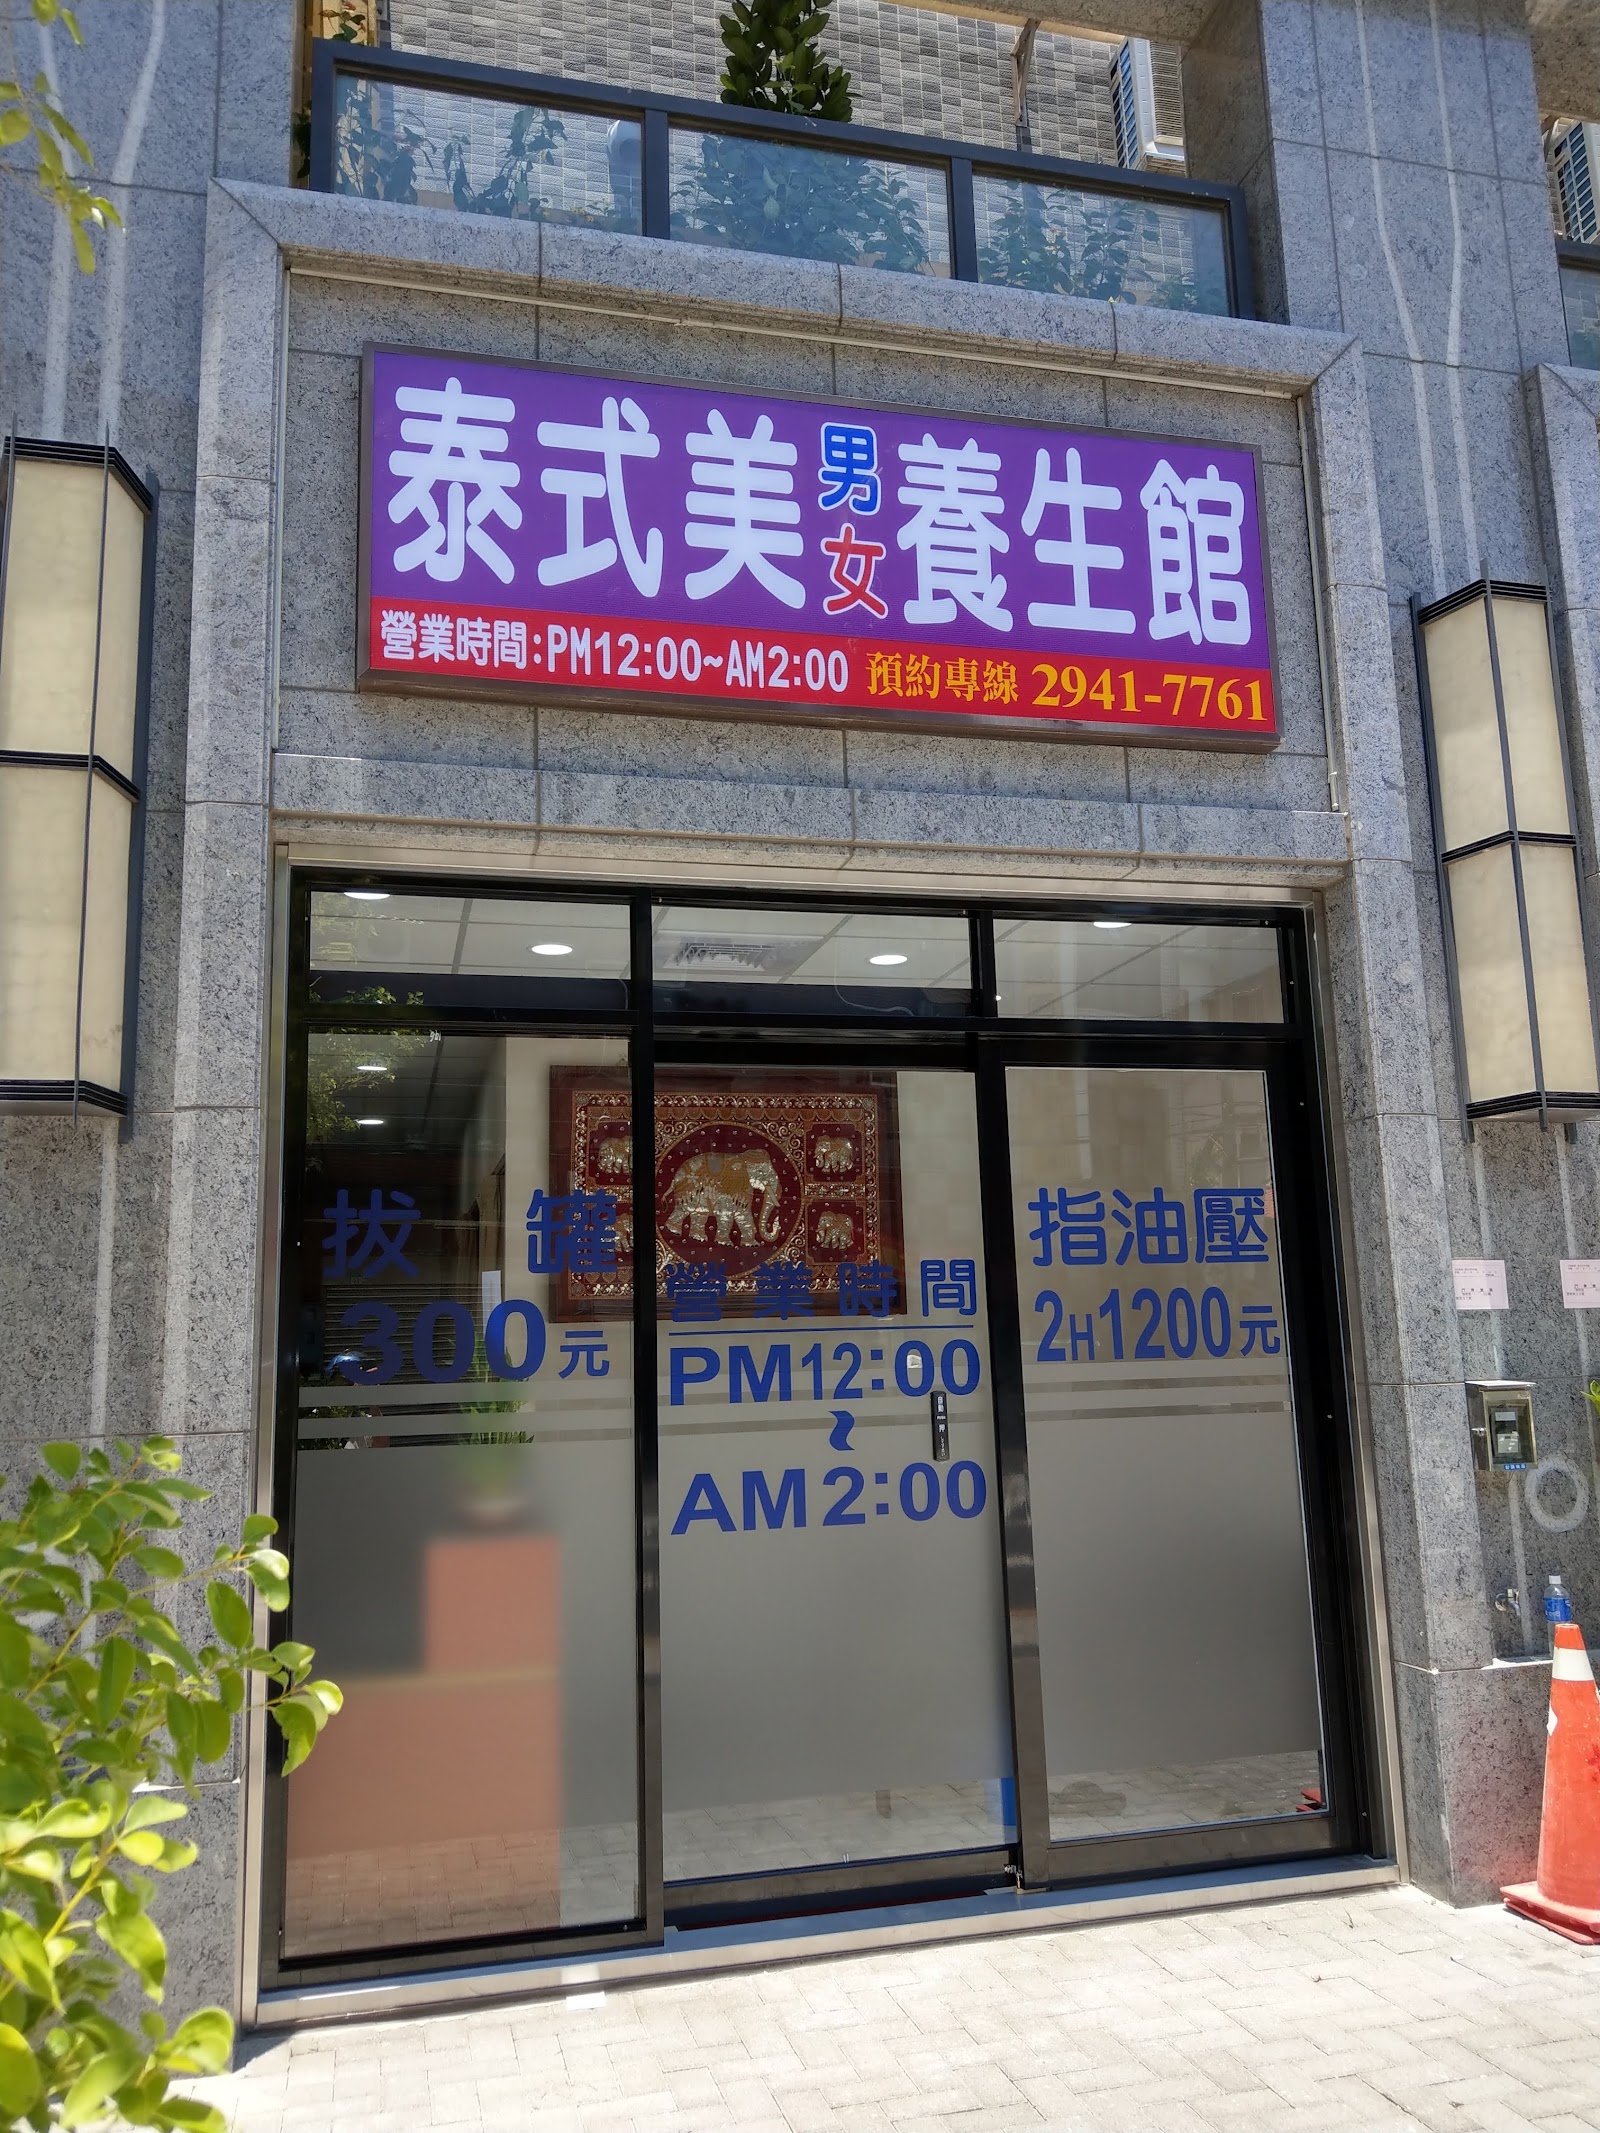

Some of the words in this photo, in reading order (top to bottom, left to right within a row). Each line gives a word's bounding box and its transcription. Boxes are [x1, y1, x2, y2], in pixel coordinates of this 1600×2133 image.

[865, 650, 1019, 704] 預約專線
[1031, 663, 1268, 721] 2941-7761
[1027, 1186, 1270, 1267] 指油壓
[669, 1339, 981, 1406] PM12:00
